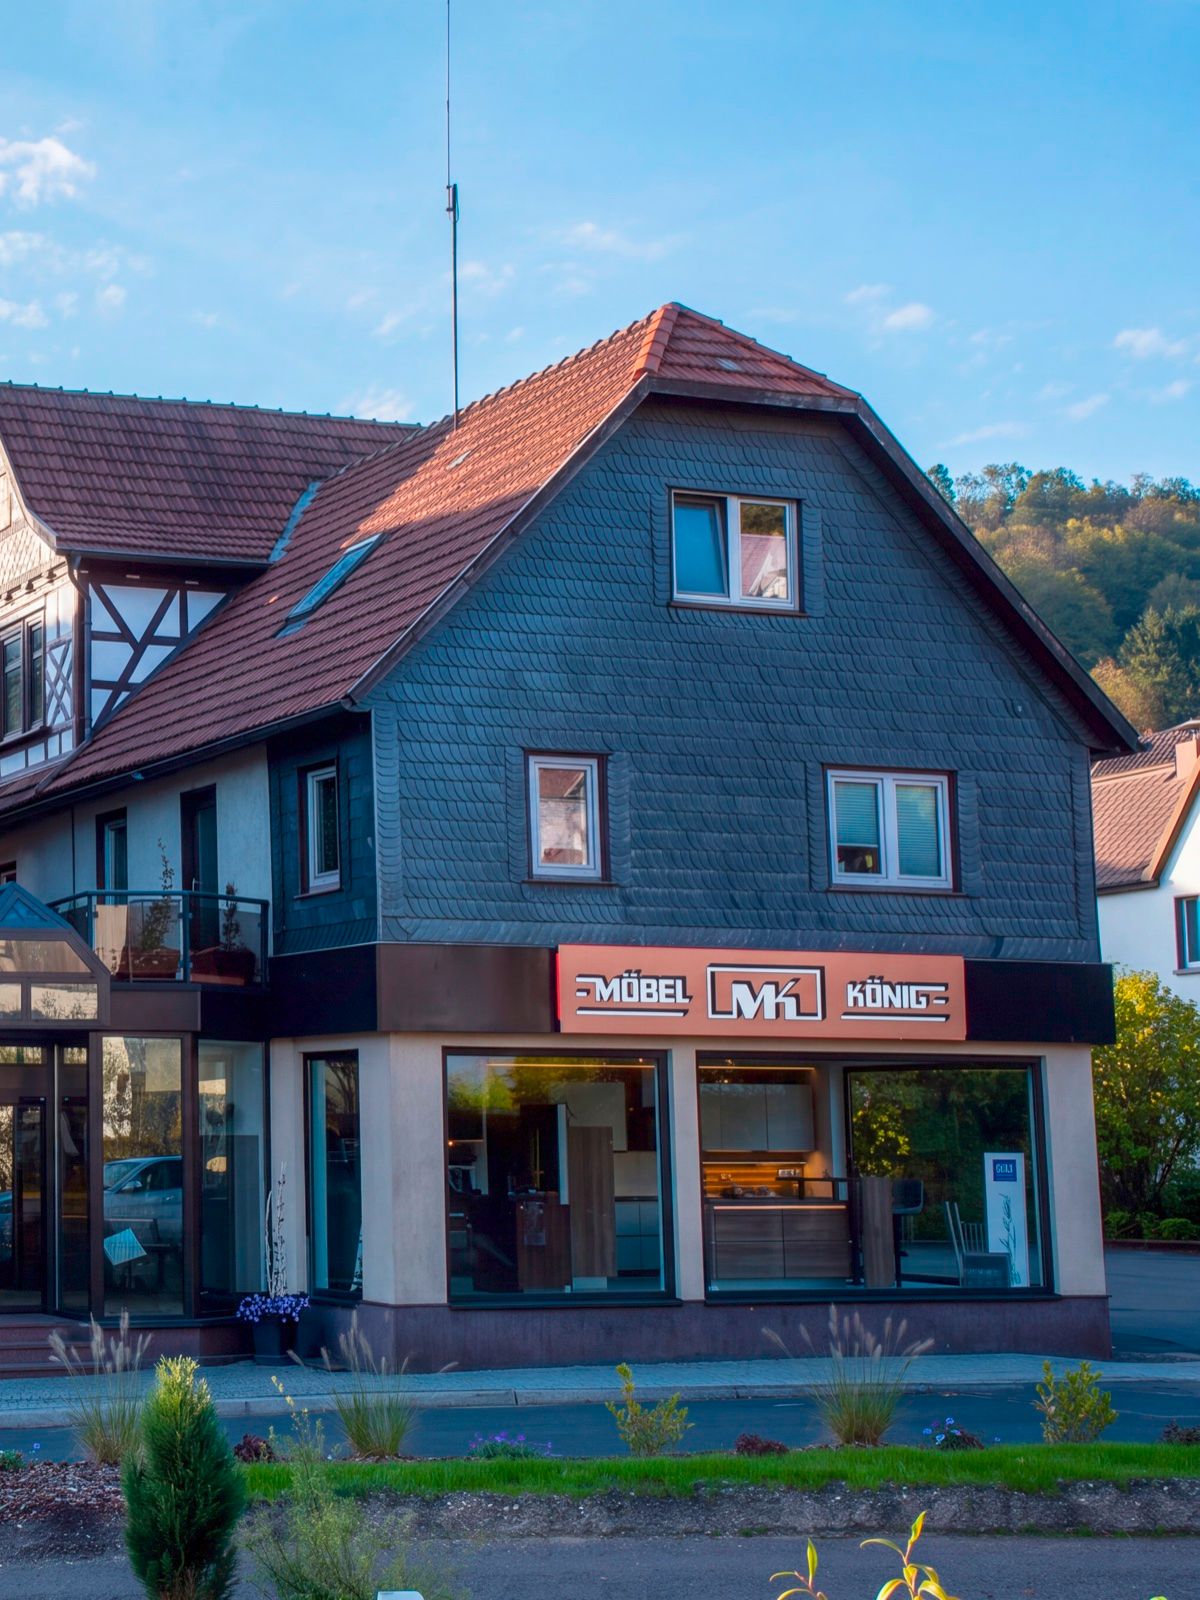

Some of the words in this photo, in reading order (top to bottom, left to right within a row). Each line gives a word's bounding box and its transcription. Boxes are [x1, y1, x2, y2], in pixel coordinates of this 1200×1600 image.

[594, 971, 692, 1004] MÖBEL
[731, 978, 802, 1020] MK
[847, 976, 929, 1009] KÖNIG
